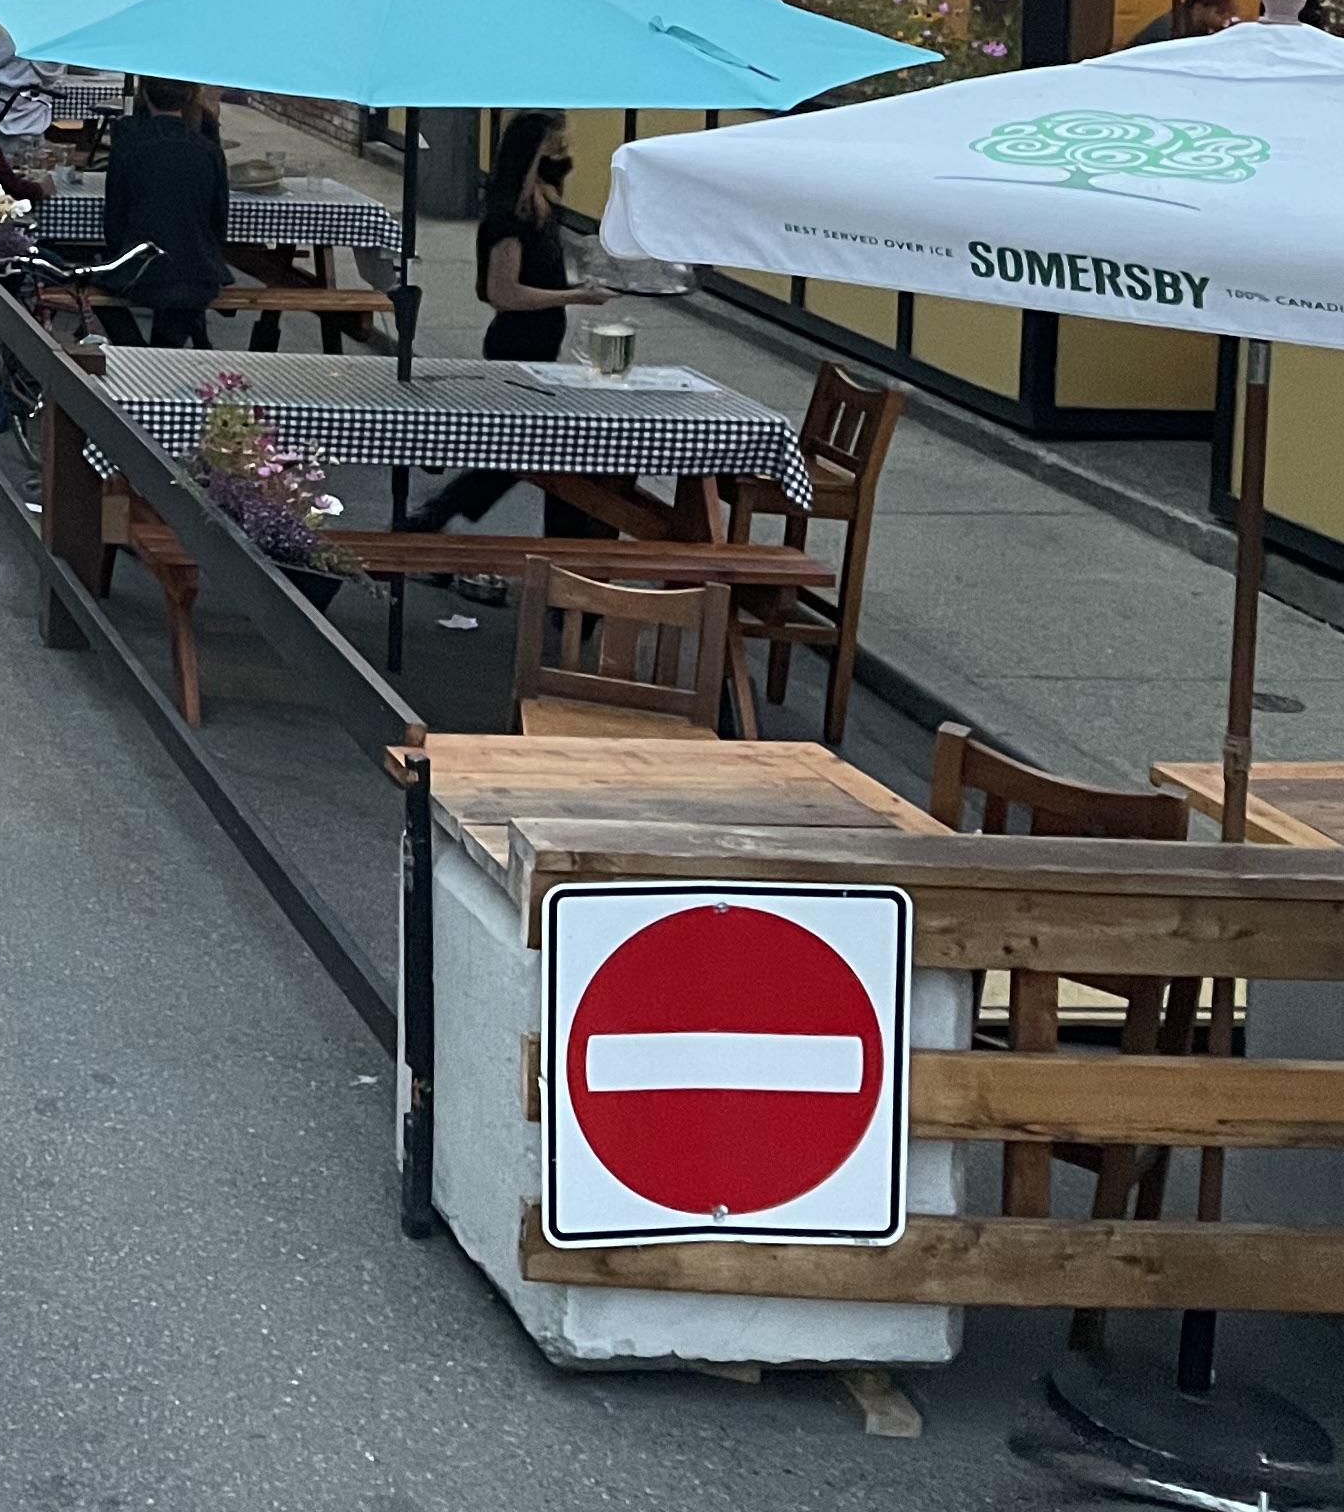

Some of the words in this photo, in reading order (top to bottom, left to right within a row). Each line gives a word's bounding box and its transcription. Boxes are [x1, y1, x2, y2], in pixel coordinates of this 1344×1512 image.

[784, 222, 817, 237] BEST
[823, 228, 879, 246] SERVED
[884, 238, 926, 254] OVER
[929, 245, 955, 258] ICE
[968, 240, 1210, 310] SOMERSBY
[1225, 288, 1271, 303] 100%
